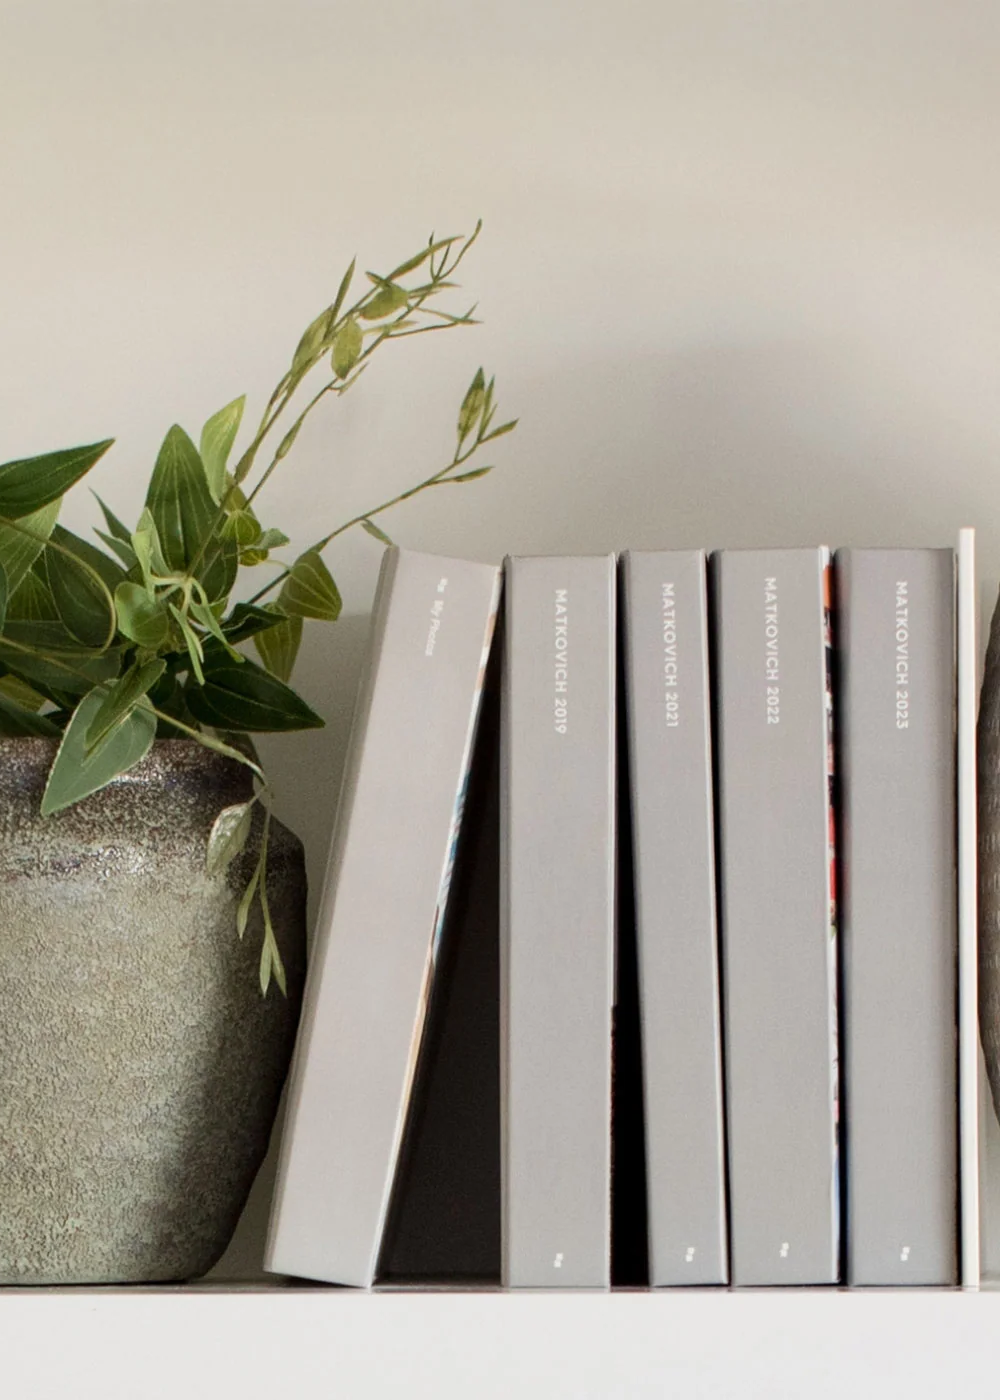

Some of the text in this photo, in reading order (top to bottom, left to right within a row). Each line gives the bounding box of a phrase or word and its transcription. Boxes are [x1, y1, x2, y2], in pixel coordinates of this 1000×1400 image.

[425, 599, 444, 656] My Photos
[554, 588, 568, 734] MATKOVICH 2019
[662, 583, 679, 727] MATKOVICH 2021
[764, 577, 780, 725] MATKOVICH 2022
[895, 581, 909, 729] MATKOVICH 2023
